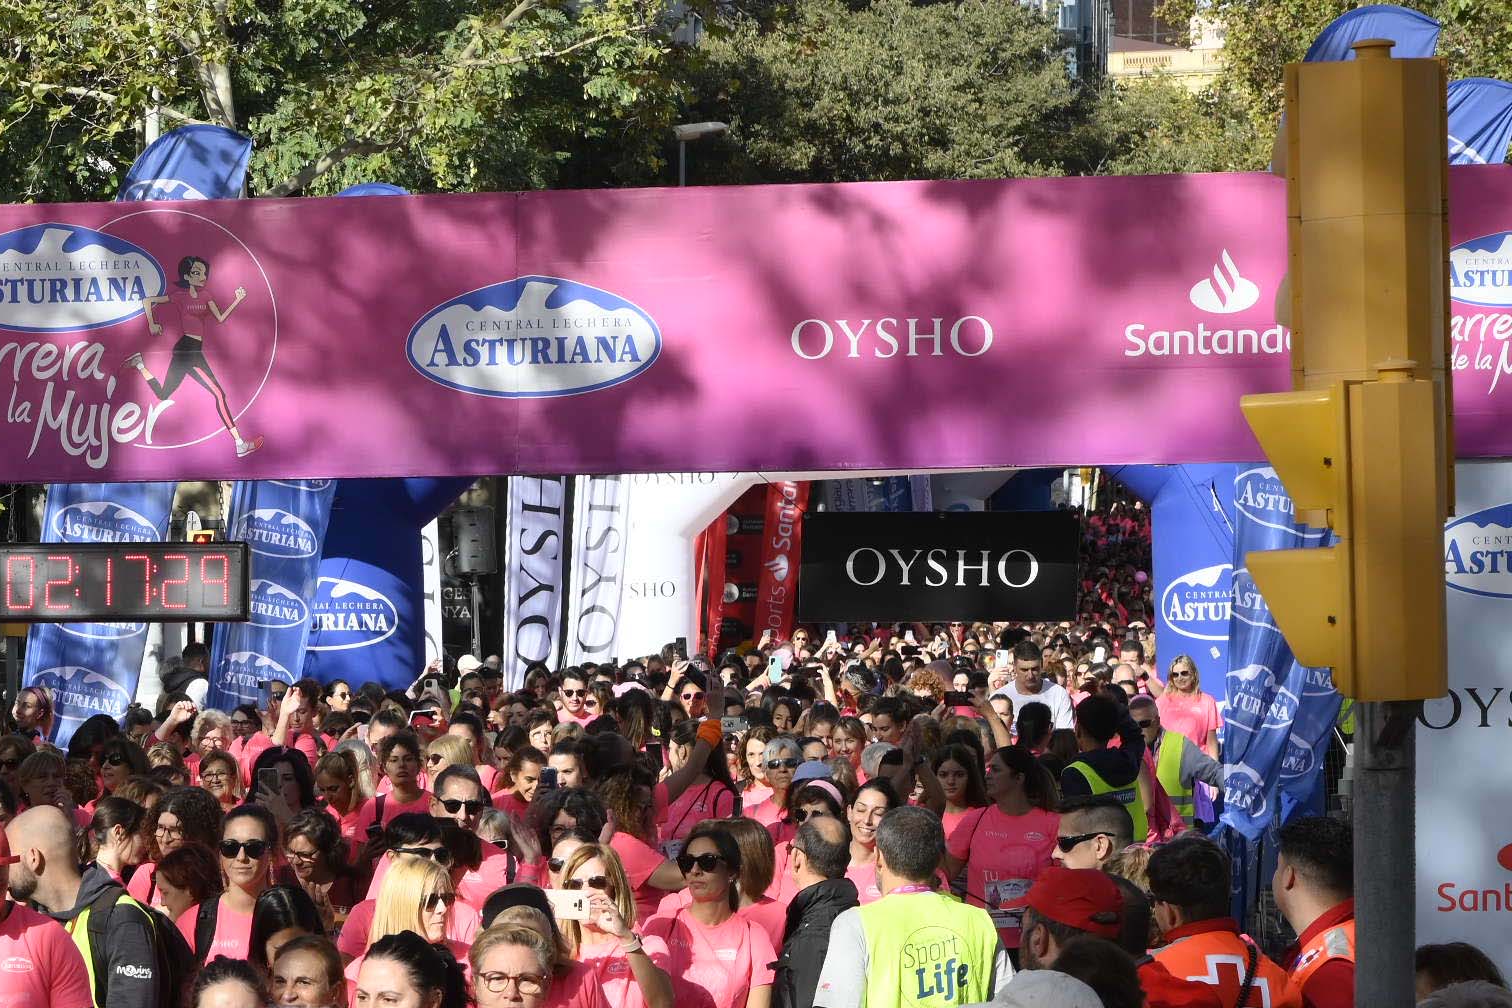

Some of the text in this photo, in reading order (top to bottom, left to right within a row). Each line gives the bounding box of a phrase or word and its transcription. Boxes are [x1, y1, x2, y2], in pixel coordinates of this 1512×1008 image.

[70, 260, 140, 271] LECHERA
[1450, 261, 1512, 287] ASTU
[465, 317, 633, 332] CENTRAL LECHERA
[791, 316, 994, 360] OYSHO
[426, 322, 642, 368] ASTURIANA
[1474, 342, 1492, 370] la
[8, 383, 31, 423] la
[27, 375, 175, 469] Mujer
[6, 555, 230, 610] 02:17:29
[846, 548, 1039, 588] OYSHO
[335, 602, 384, 610] LECHERA
[904, 936, 959, 970] Sport
[916, 958, 969, 1001] Life
